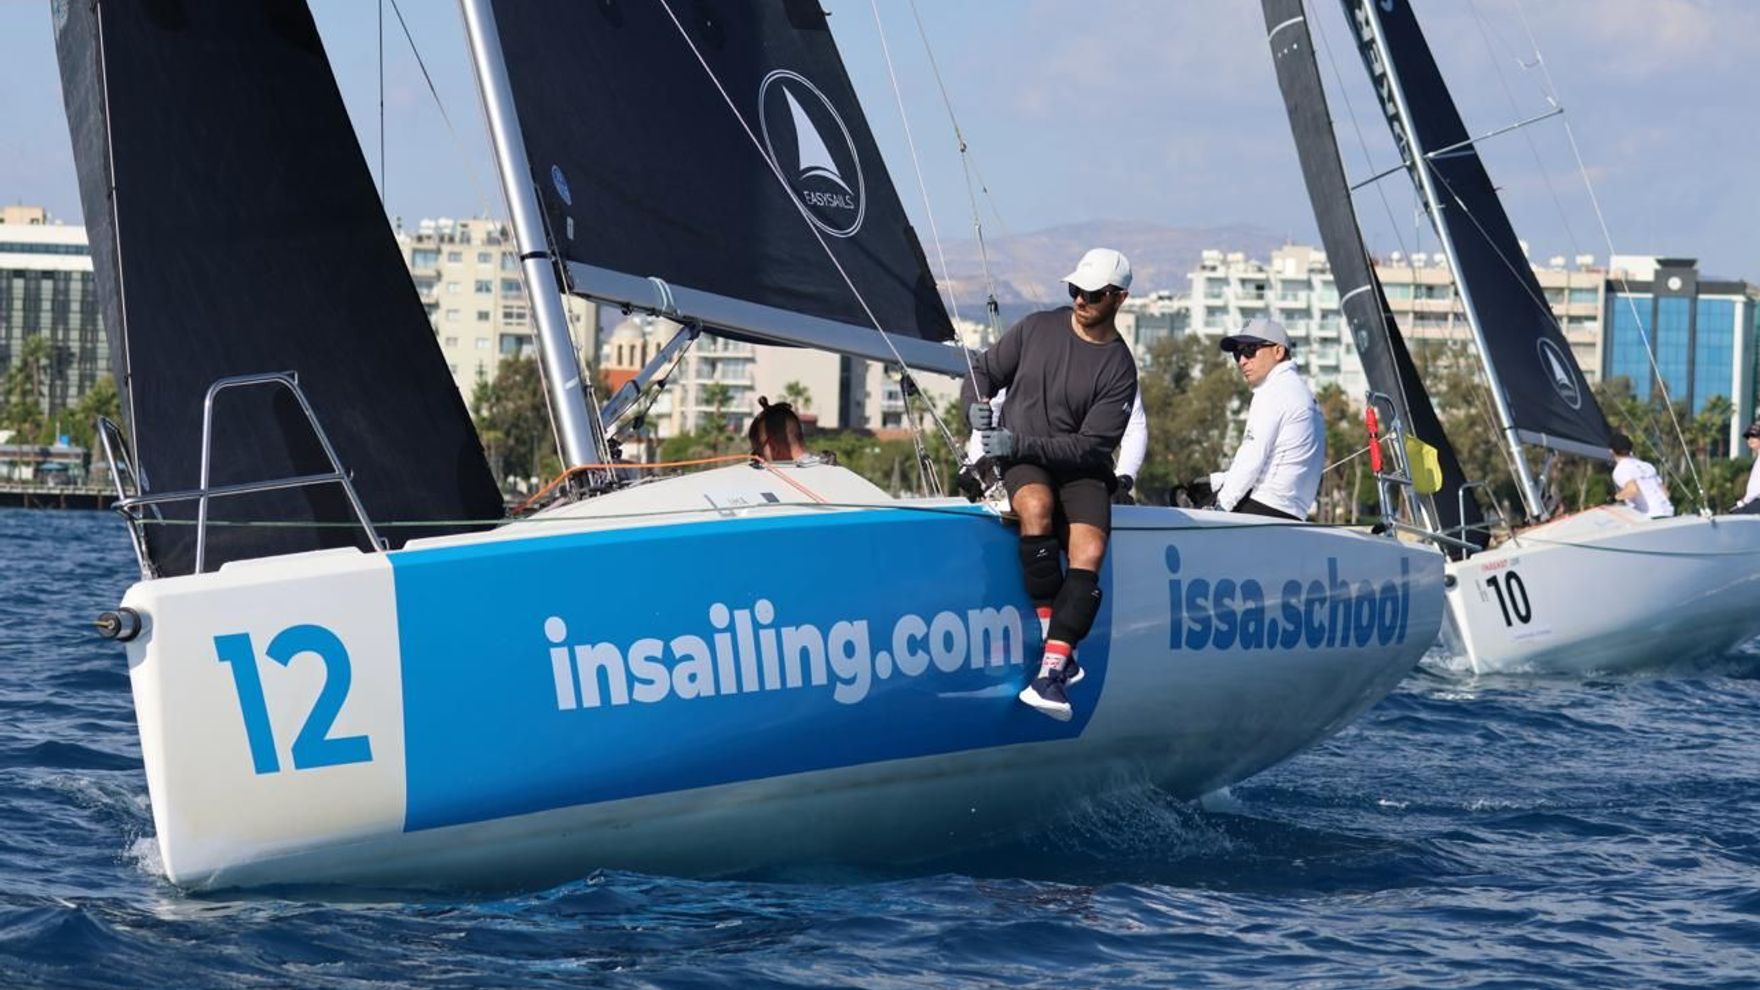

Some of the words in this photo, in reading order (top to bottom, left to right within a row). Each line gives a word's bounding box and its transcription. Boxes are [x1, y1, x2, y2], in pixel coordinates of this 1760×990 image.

[803, 190, 855, 209] EASYSAILS
[1165, 544, 1410, 651] issa.school
[1486, 570, 1532, 627] 10
[213, 623, 373, 775] 12
[544, 598, 1024, 711] insailing.com
